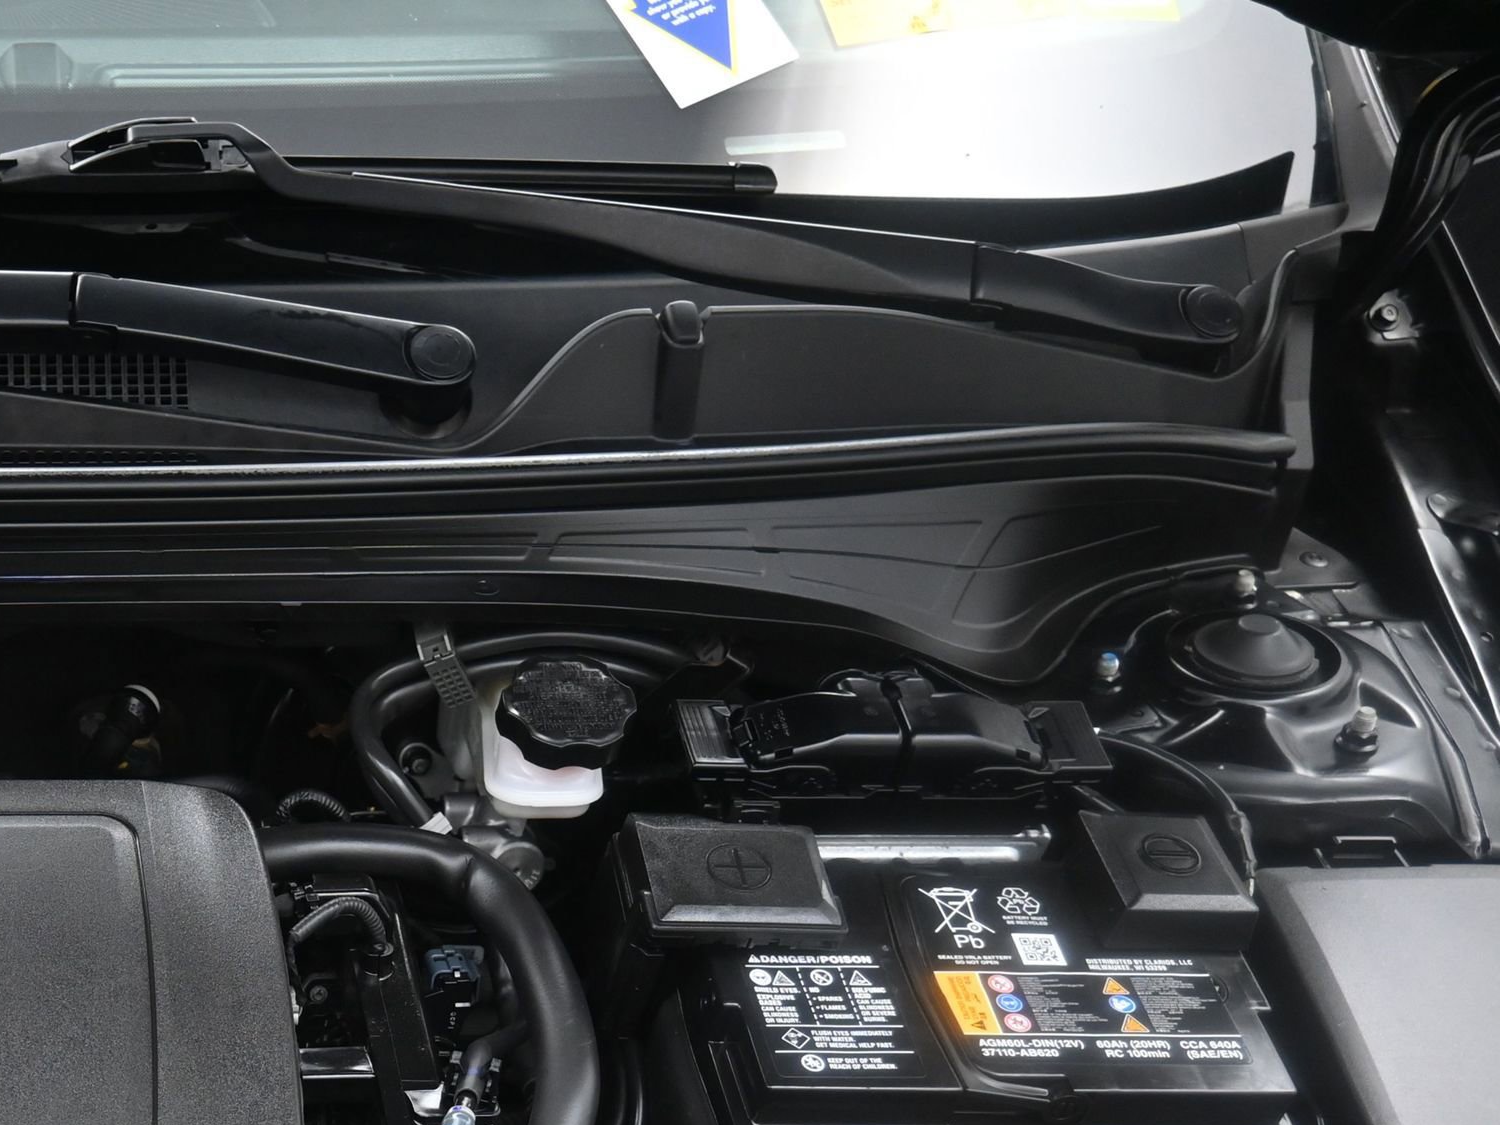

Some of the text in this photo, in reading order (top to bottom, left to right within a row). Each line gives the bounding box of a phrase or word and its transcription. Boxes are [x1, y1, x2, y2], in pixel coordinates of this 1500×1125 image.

[953, 934, 985, 949] Pb
[760, 955, 872, 964] DANGER/POISON
[979, 1038, 1241, 1050] AGM60L-DIN(12V) 60Ah (20HR) CCA 640A
[981, 1048, 1244, 1060] 37110-AB620 RC 100min (SAE/EN)
